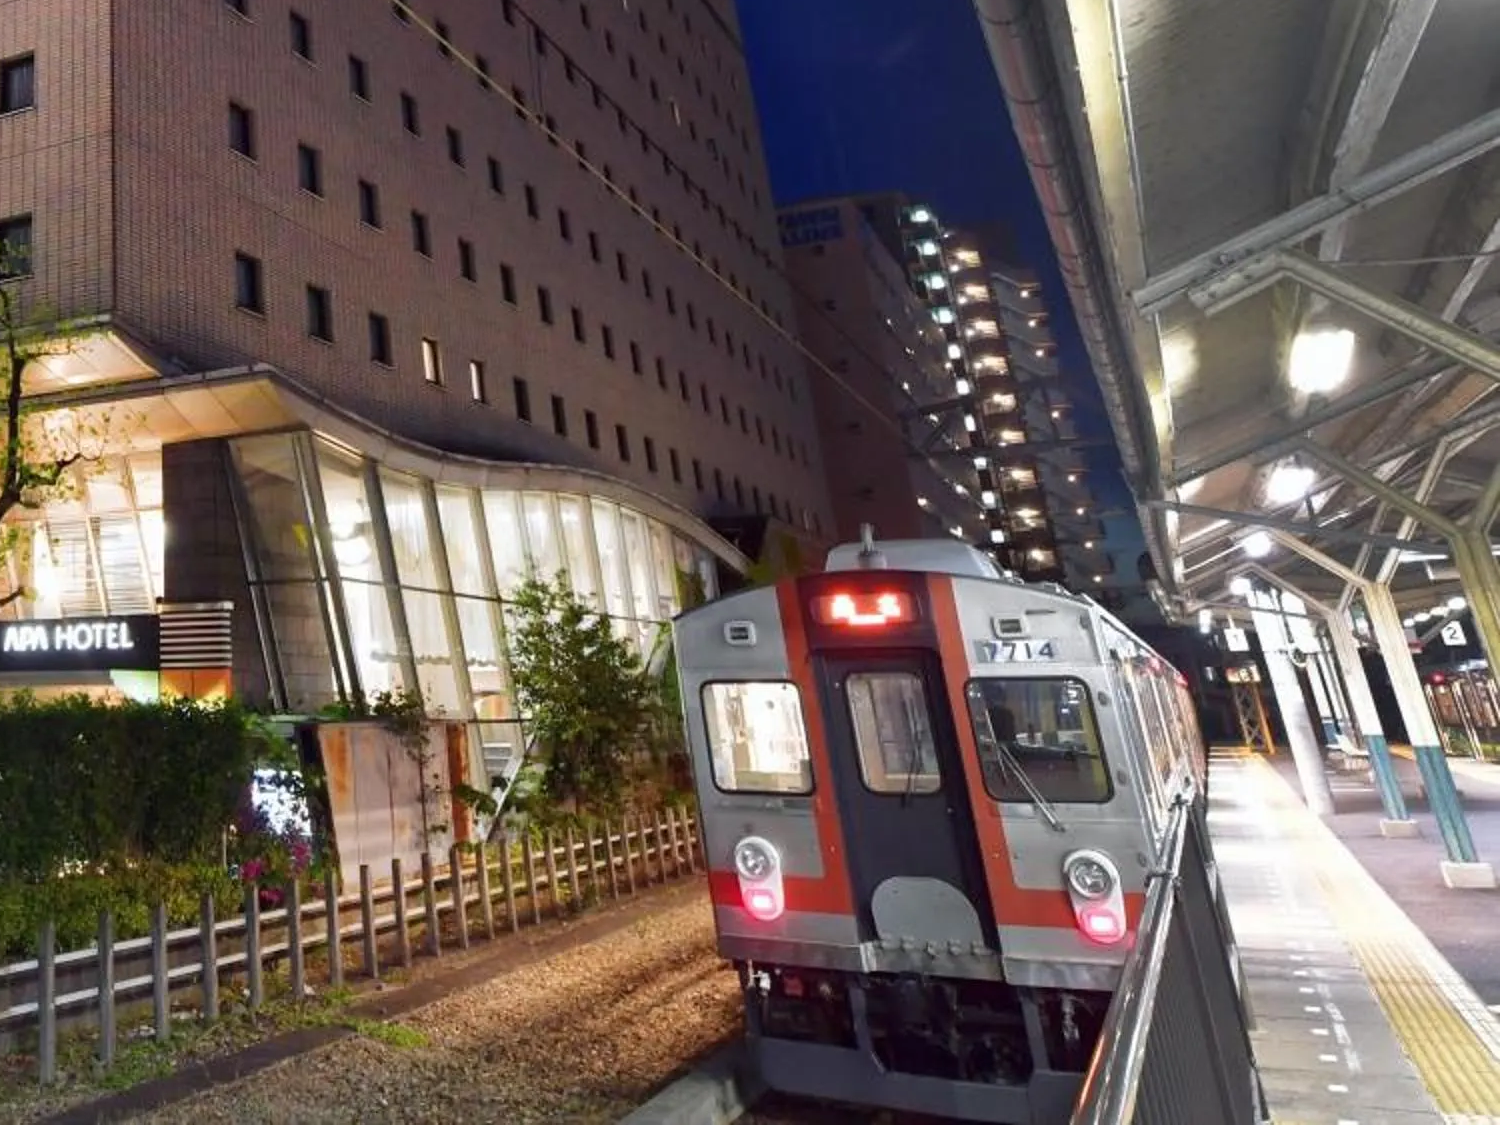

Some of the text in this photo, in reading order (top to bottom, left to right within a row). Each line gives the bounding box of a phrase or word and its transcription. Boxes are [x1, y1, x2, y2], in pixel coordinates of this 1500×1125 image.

[3, 621, 135, 652] APA HOTEL
[981, 640, 1055, 661] 7714
